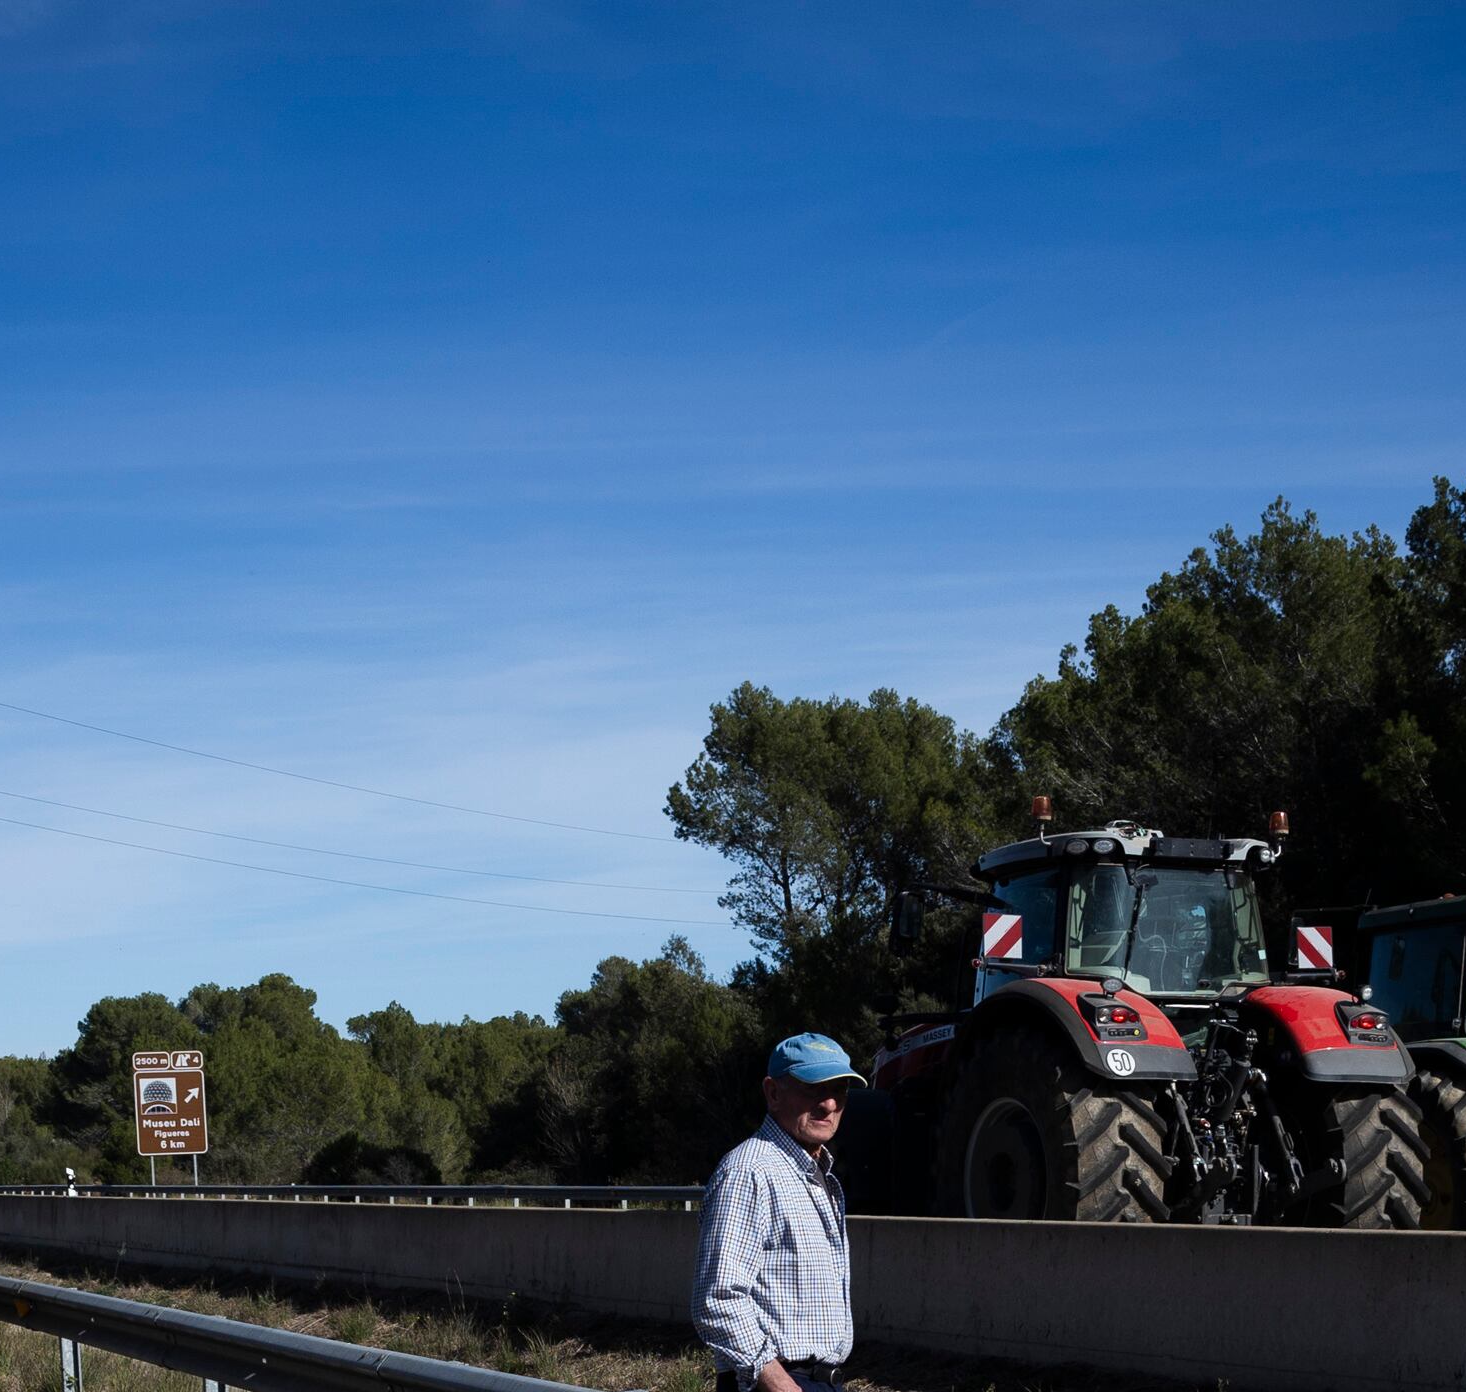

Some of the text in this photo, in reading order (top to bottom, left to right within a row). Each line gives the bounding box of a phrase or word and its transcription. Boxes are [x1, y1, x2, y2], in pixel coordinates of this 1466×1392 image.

[923, 1029, 951, 1041] MASSEY
[136, 1057, 158, 1065] 2500
[193, 1056, 199, 1064] 4
[1111, 1052, 1132, 1072] 50
[143, 1119, 176, 1128] Museu
[154, 1130, 190, 1138] Figueres
[160, 1140, 185, 1149] 6 km
